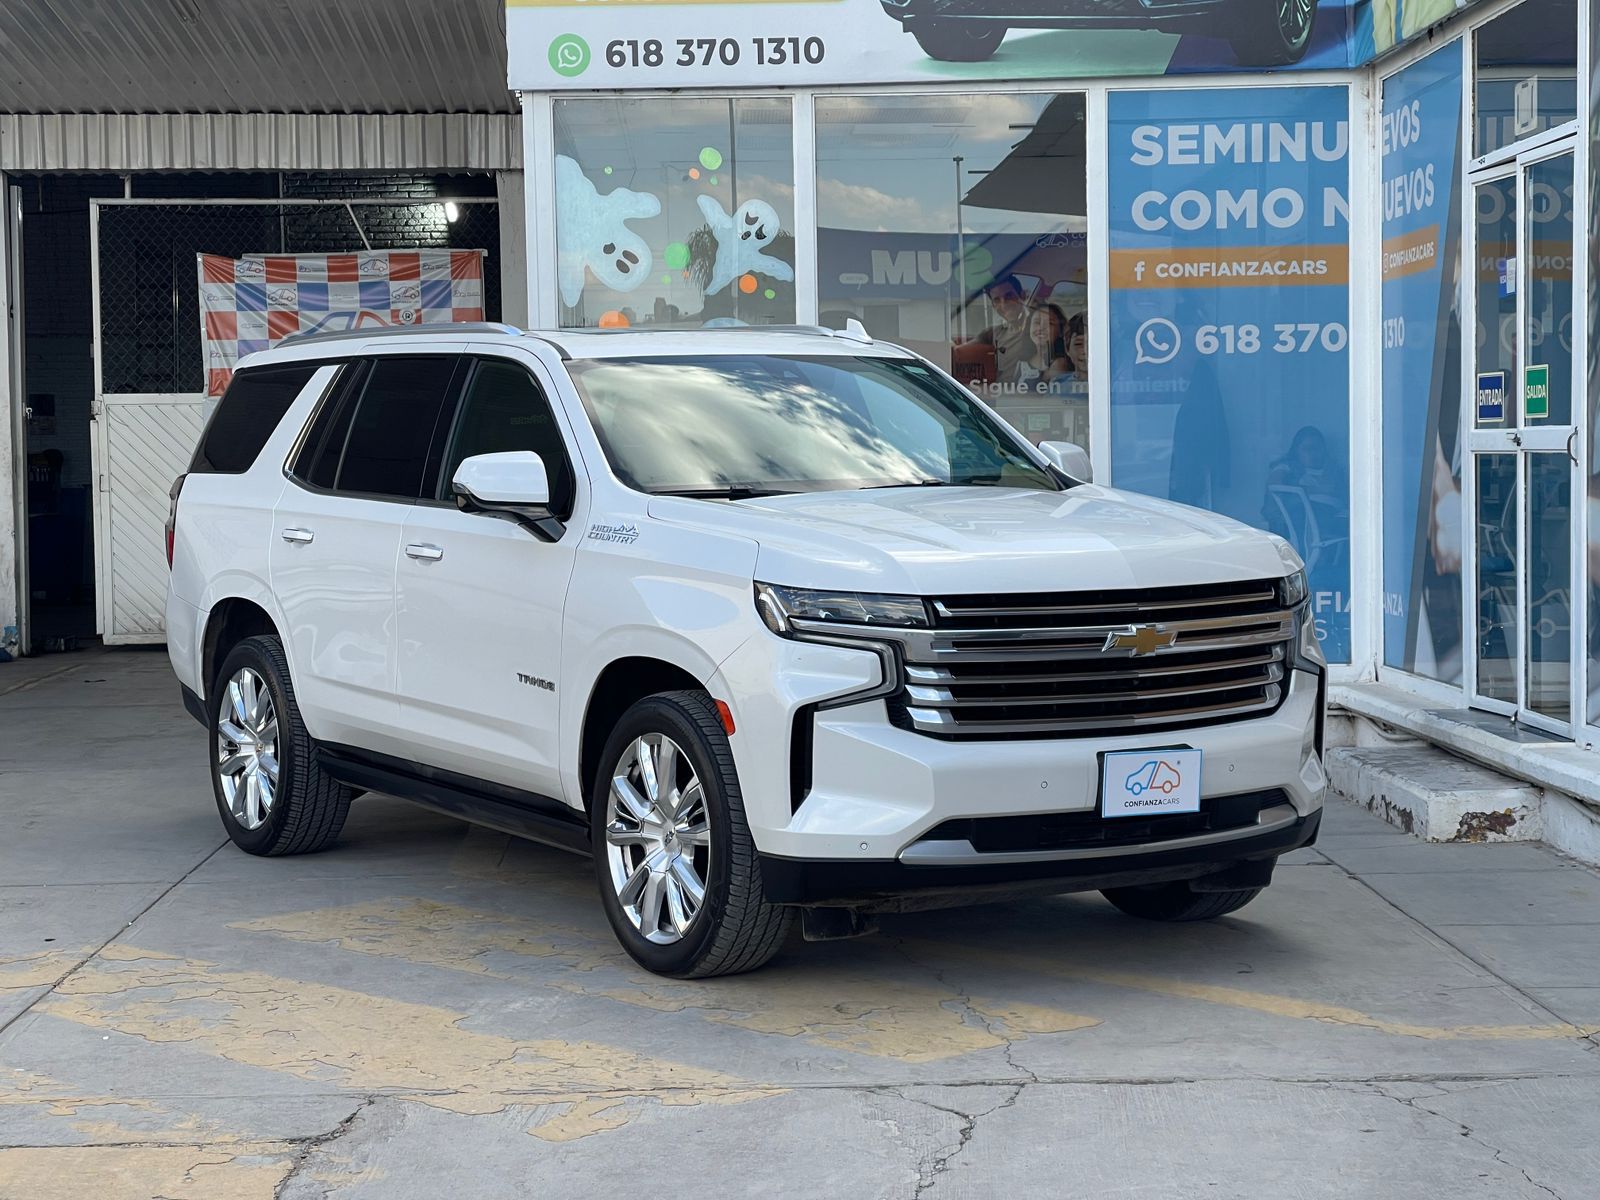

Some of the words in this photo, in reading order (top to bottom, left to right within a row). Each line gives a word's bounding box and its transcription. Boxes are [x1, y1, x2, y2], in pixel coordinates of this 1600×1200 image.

[605, 40, 664, 68] 618
[676, 38, 740, 67] 370
[752, 36, 826, 65] 1310
[1382, 163, 1435, 223] UEVOS
[1131, 187, 1305, 231] COMO
[1389, 241, 1435, 268] CONFIANZACARS
[1155, 260, 1328, 278] CONFIANZACARS
[1195, 324, 1261, 355] 618
[1273, 322, 1348, 353] 370
[1383, 316, 1405, 349] 1310
[969, 379, 1028, 397] Sigue
[1035, 381, 1063, 394] en
[1479, 387, 1502, 408] ENTRADA
[1526, 383, 1546, 400] SALIDA
[588, 531, 638, 545] COUNTRY
[1124, 798, 1180, 808] CONFIANZACARS
